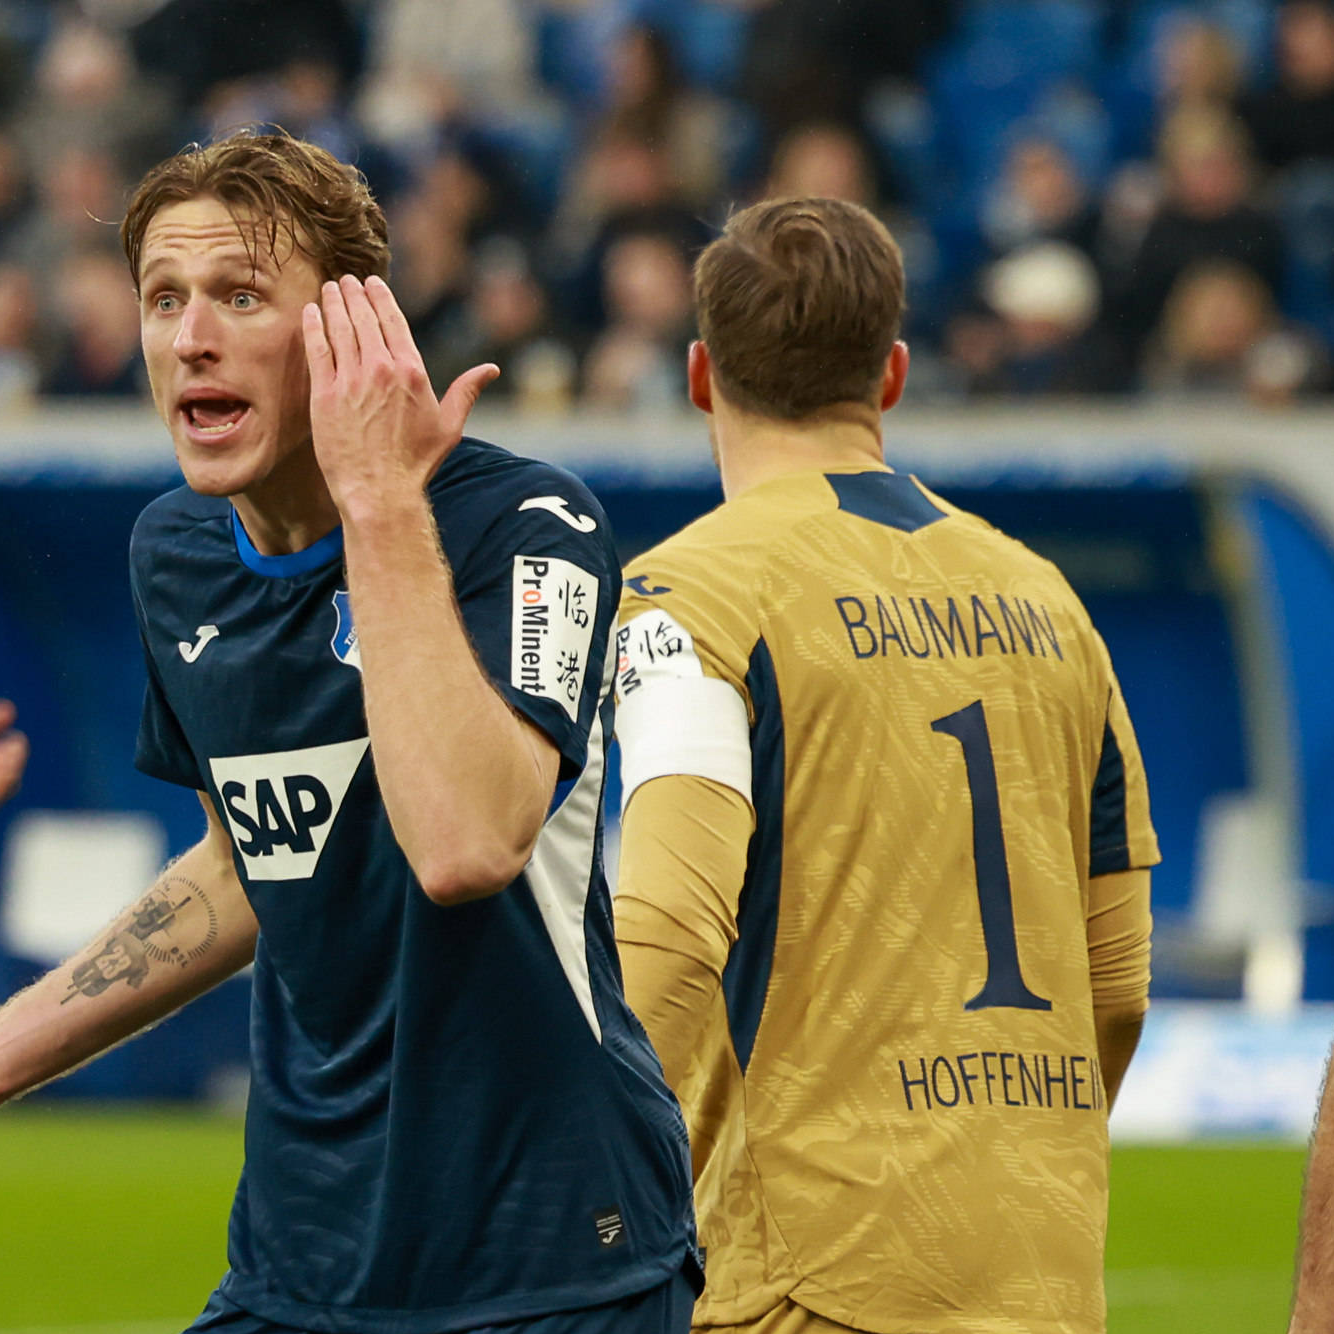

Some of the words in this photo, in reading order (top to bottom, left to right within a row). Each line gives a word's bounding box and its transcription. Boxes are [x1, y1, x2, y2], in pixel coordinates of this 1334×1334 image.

[521, 559, 549, 693] ProMinent
[835, 594, 1064, 662] BAUMANN
[222, 774, 333, 858] SAP
[931, 699, 1052, 1012] 1
